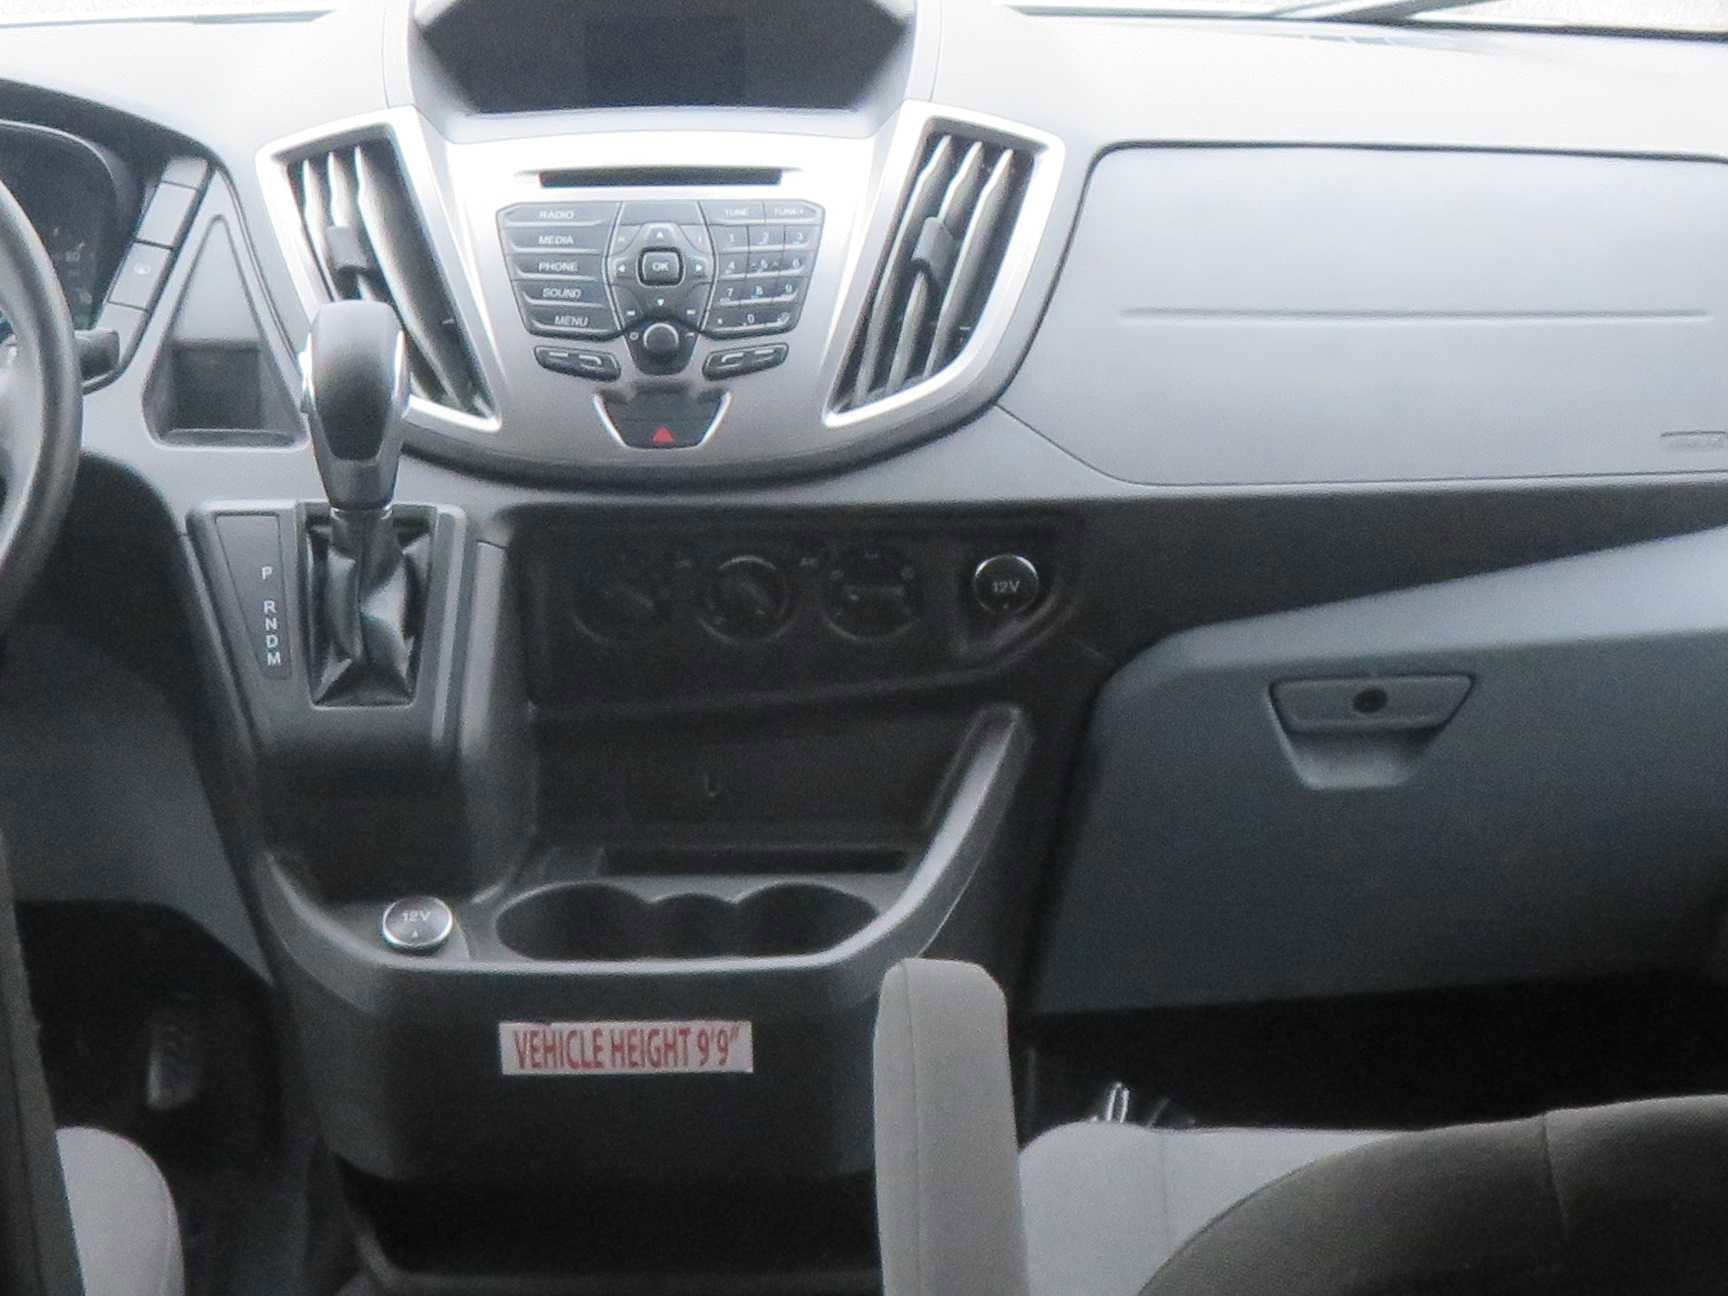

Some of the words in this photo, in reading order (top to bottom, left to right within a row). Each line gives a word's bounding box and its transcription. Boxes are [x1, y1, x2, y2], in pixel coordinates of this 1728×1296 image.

[538, 209, 574, 219] RADIO
[538, 235, 574, 245] MEDIA
[538, 262, 578, 272] PHONE
[652, 262, 669, 272] OK
[542, 288, 582, 299] SOUND
[555, 315, 589, 327] MENU
[261, 566, 273, 580] P
[993, 580, 1020, 593] 12V
[264, 600, 277, 614] R
[265, 616, 278, 631] N
[266, 635, 279, 648] D
[403, 911, 431, 922] 12V
[513, 1027, 604, 1070] VEHICLE
[610, 1027, 691, 1068] HEIGHT
